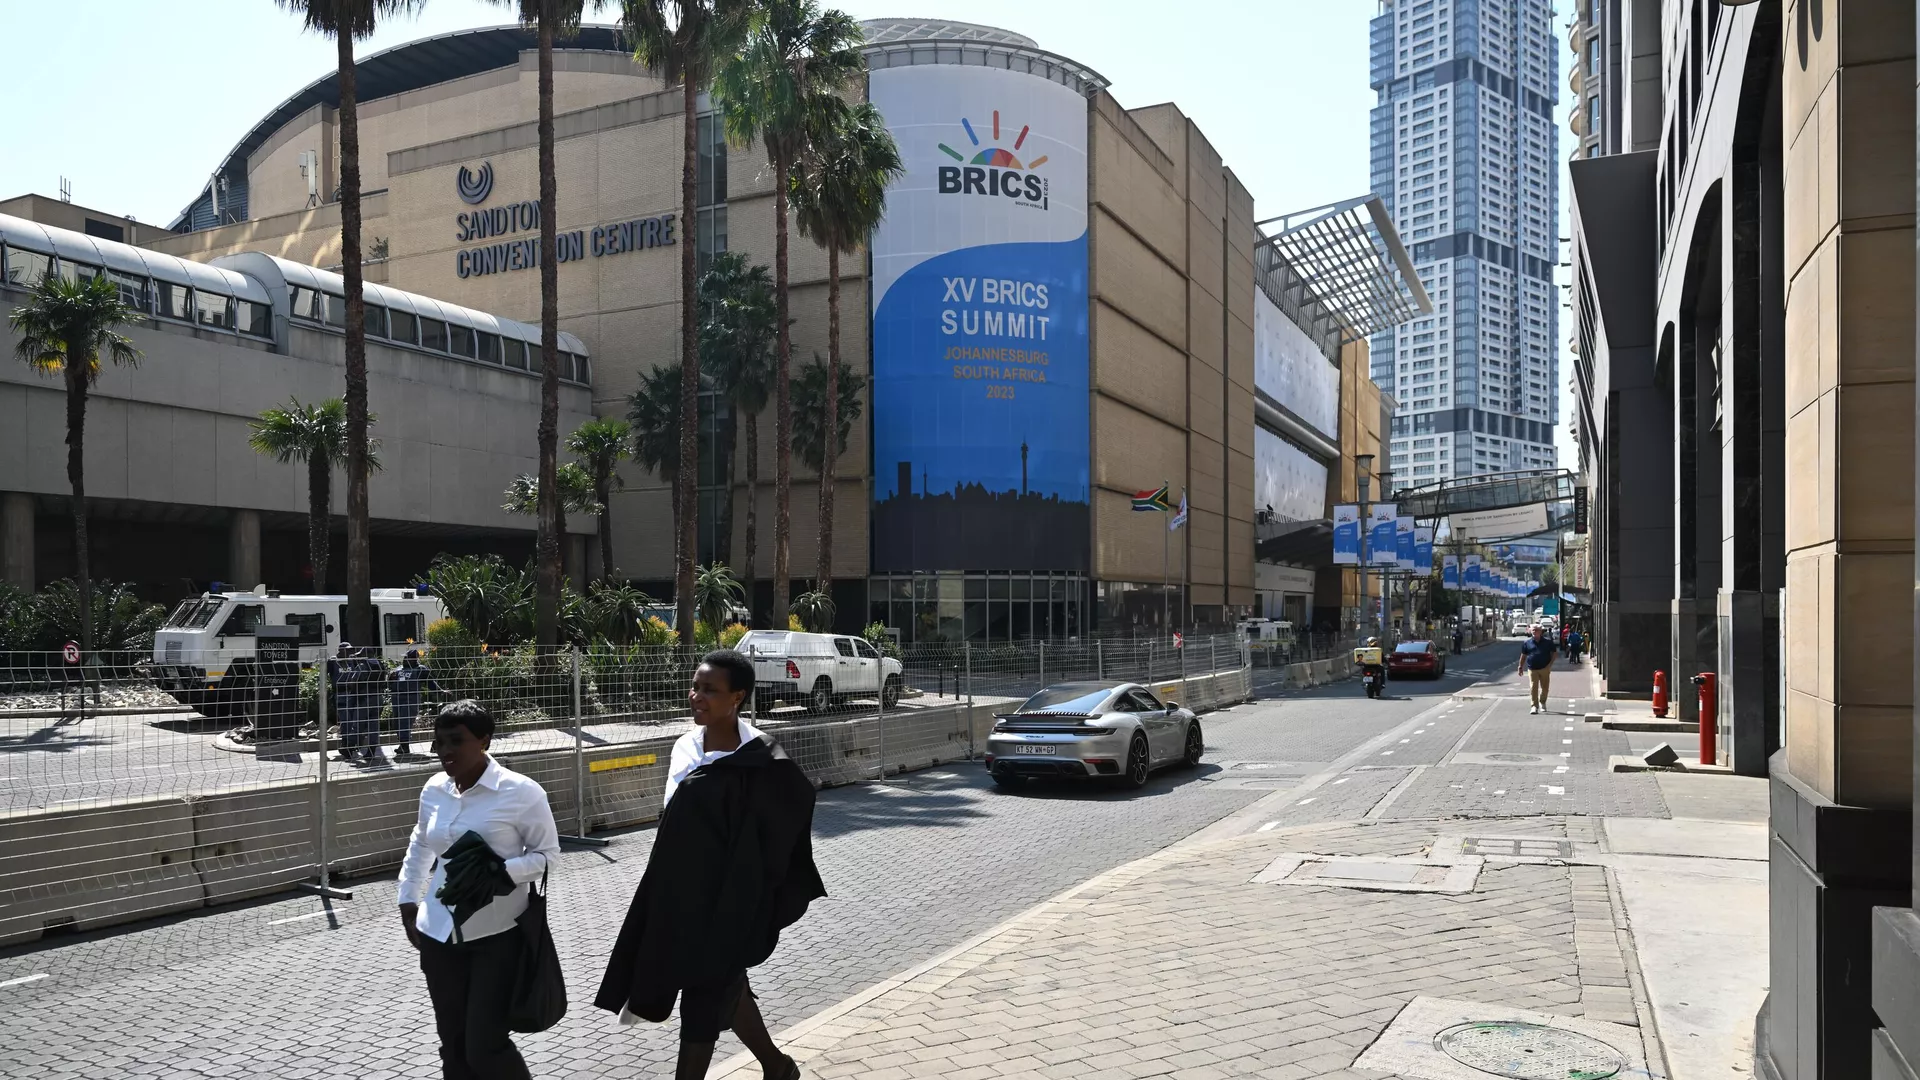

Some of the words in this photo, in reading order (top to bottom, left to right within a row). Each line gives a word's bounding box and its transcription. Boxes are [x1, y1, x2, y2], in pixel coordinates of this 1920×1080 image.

[938, 166, 1042, 202] BRICS
[590, 214, 676, 258] CENTRE
[942, 277, 976, 302] XV
[982, 278, 1049, 310] BRICS
[942, 309, 1050, 340] SUMMIT
[944, 346, 1049, 366] JOHANNESBURG
[954, 365, 1000, 380] SOUTH
[1002, 367, 1046, 382] AFRICA
[986, 385, 1015, 399] 2023
[264, 651, 288, 659] TOWERS
[1046, 746, 1054, 754] GP
